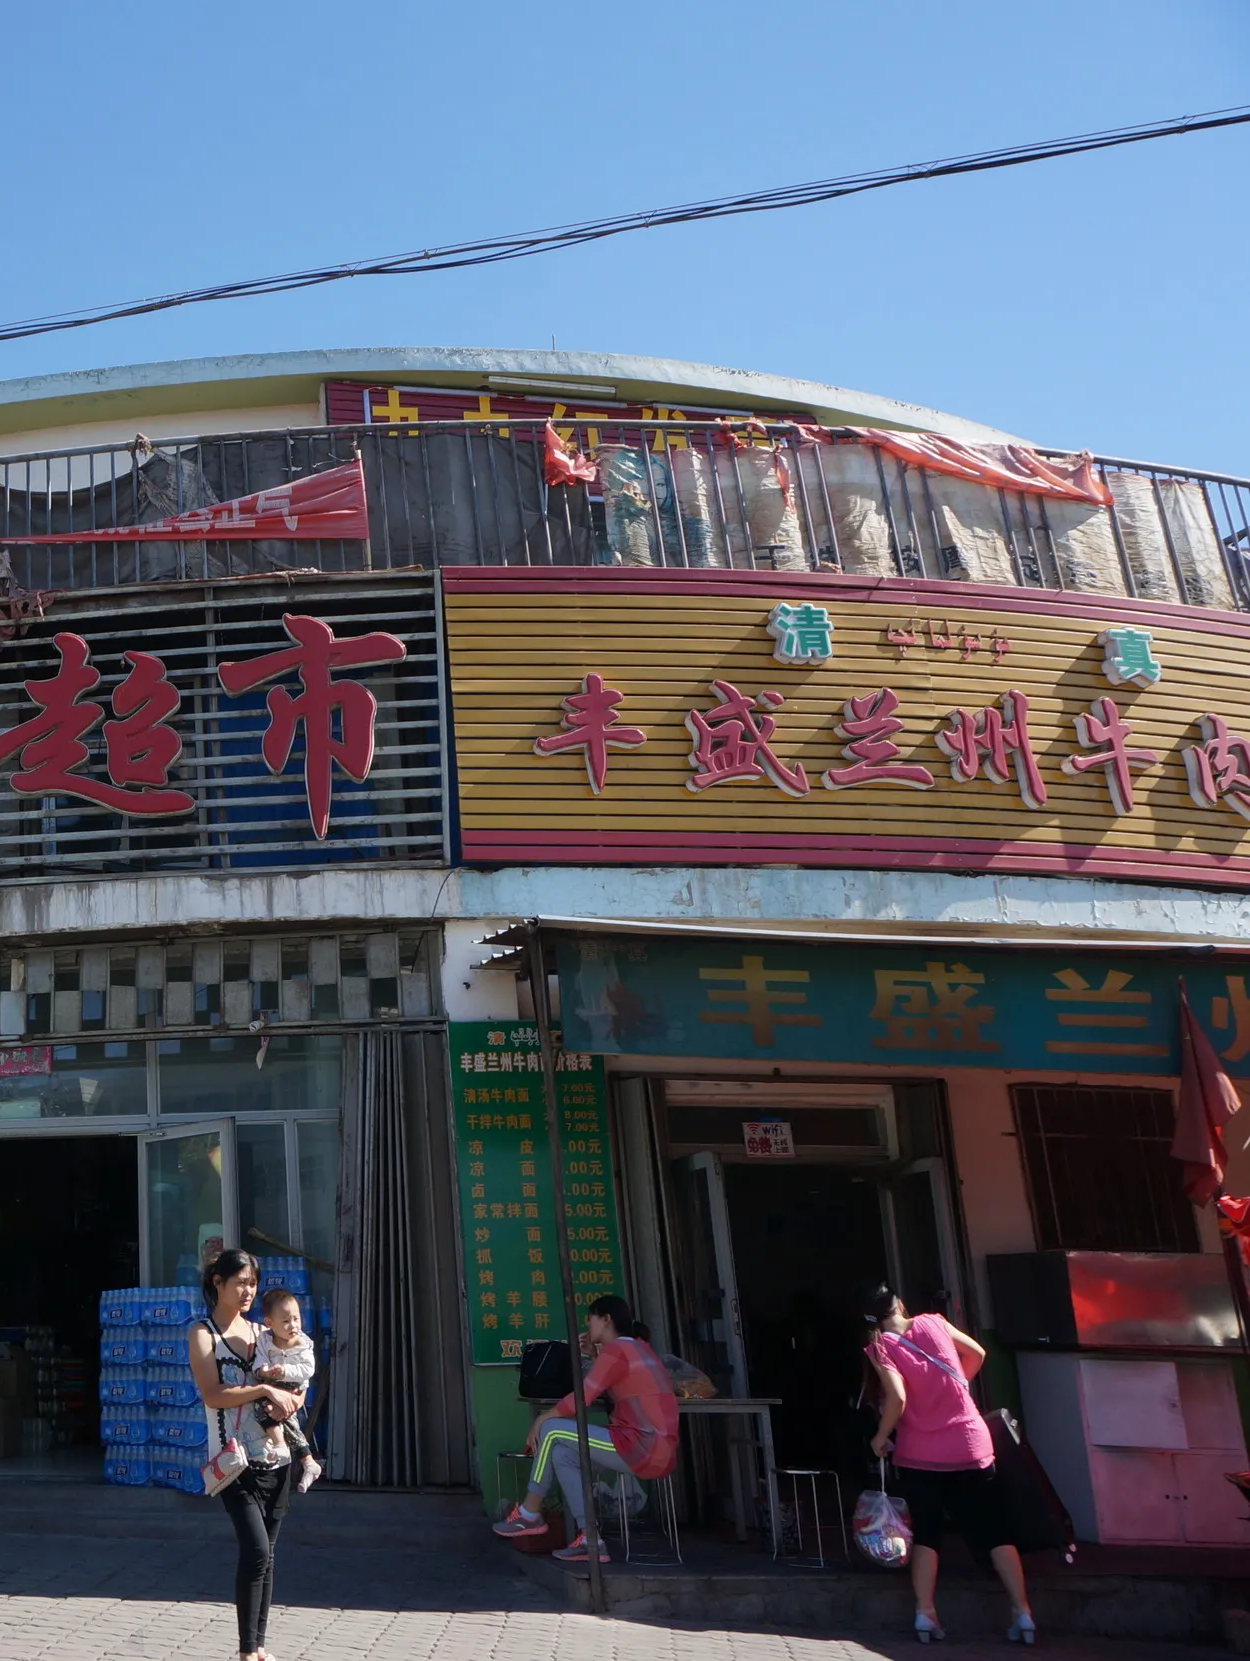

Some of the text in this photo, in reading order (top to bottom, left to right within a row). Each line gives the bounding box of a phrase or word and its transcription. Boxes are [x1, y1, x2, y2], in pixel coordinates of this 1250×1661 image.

[768, 601, 833, 665] 清
[1099, 626, 1161, 688] 真
[460, 1051, 592, 1073] 丰盛兰州牛肉价格表
[464, 1087, 530, 1104] 清汤牛肉面
[466, 1114, 532, 1131] 干拌牛肉面
[564, 1139, 602, 1154] .00元
[565, 1161, 604, 1176] .00元
[562, 1182, 606, 1197] .00元
[473, 1203, 539, 1219] 家常拌面
